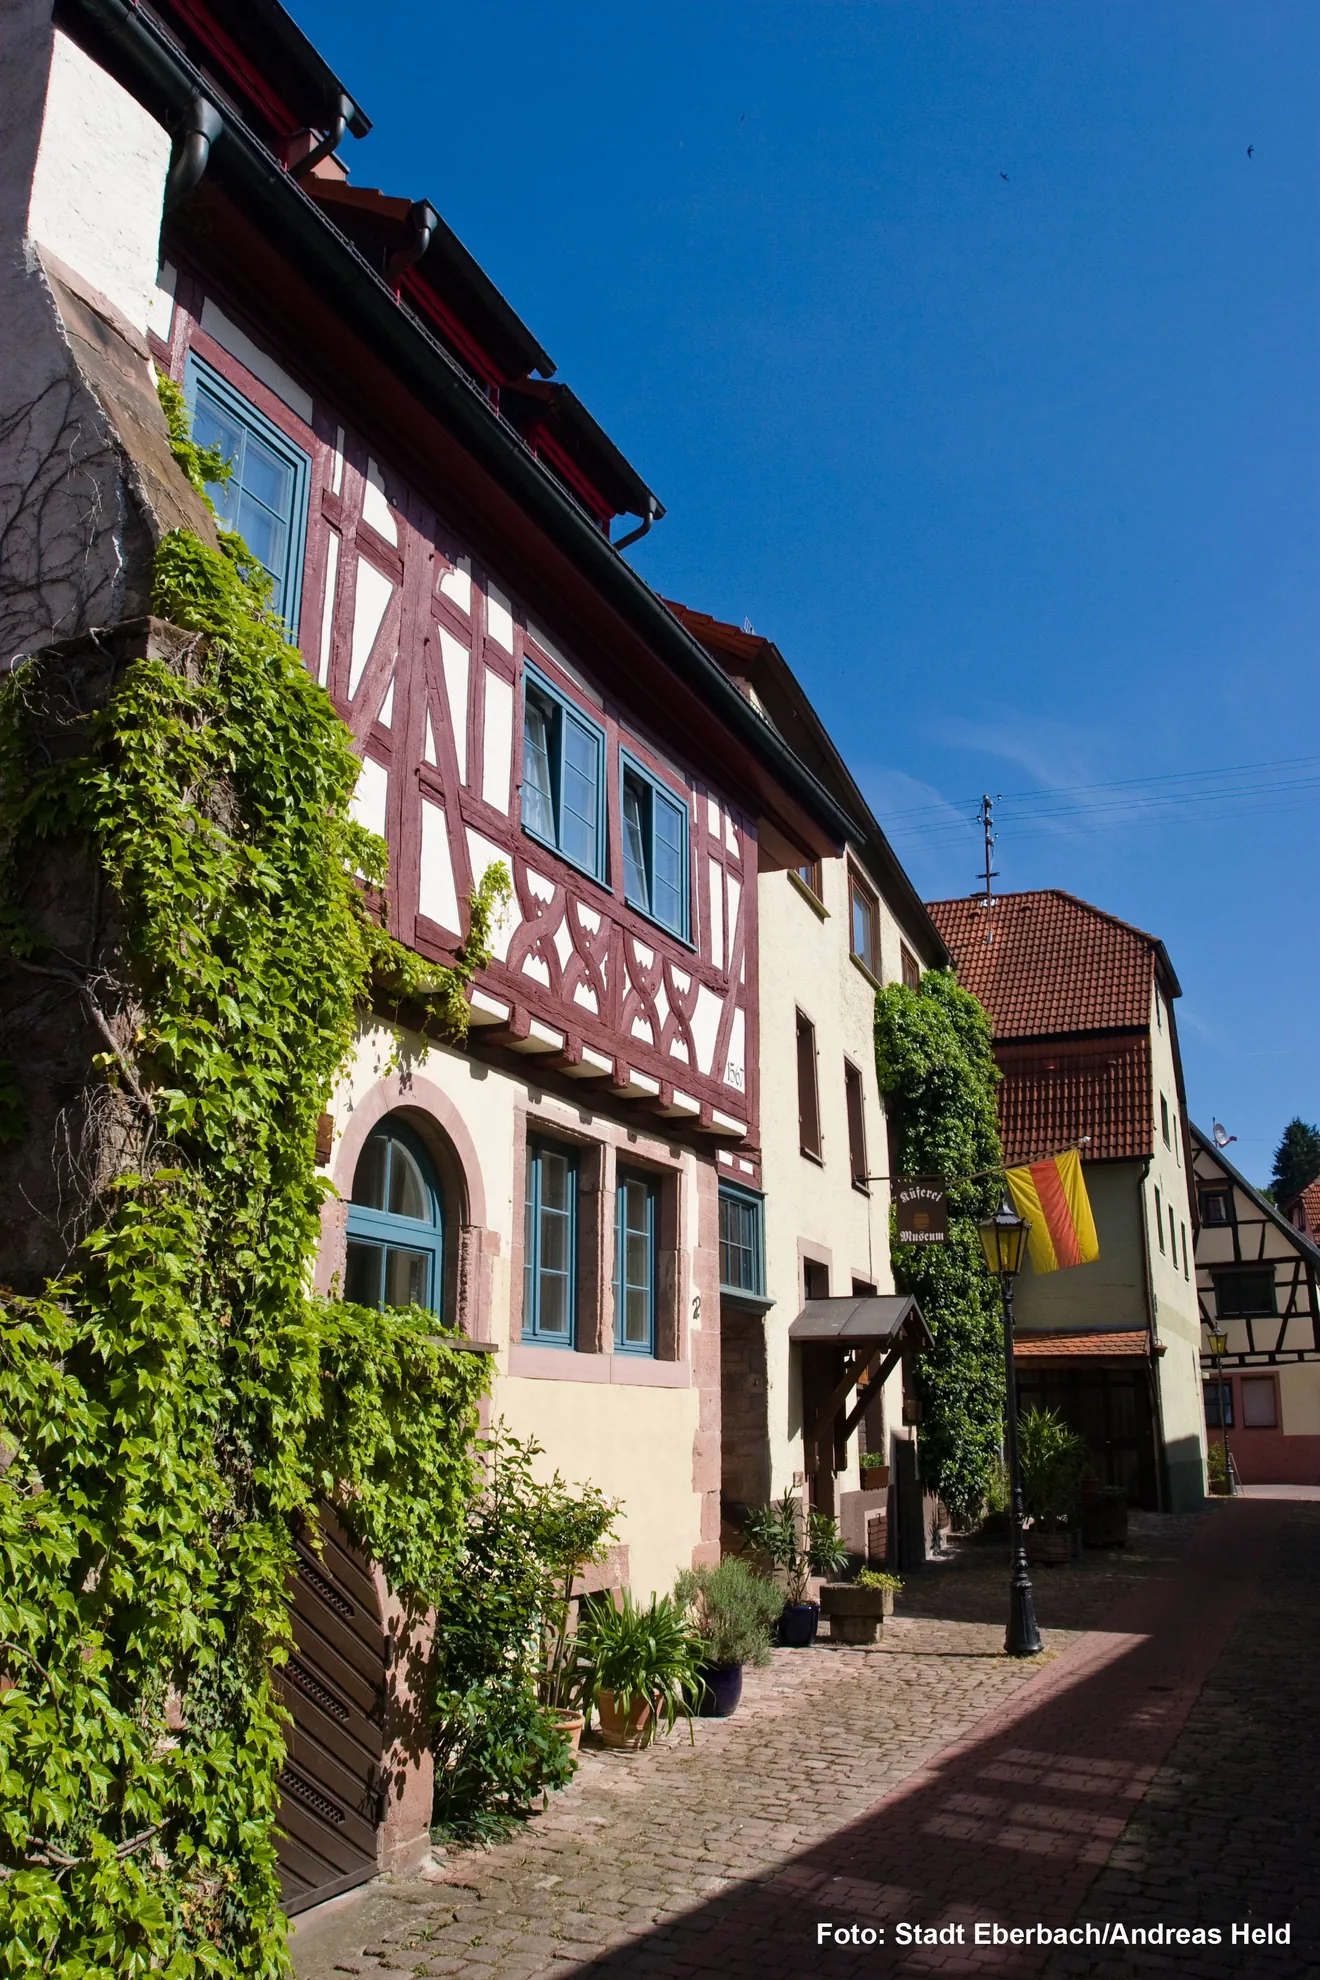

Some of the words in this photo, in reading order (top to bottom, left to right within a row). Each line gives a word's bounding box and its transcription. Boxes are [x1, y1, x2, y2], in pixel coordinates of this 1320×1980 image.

[727, 1061, 744, 1088] 1567
[900, 1186, 943, 1203] Küferei
[900, 1231, 944, 1242] Museum
